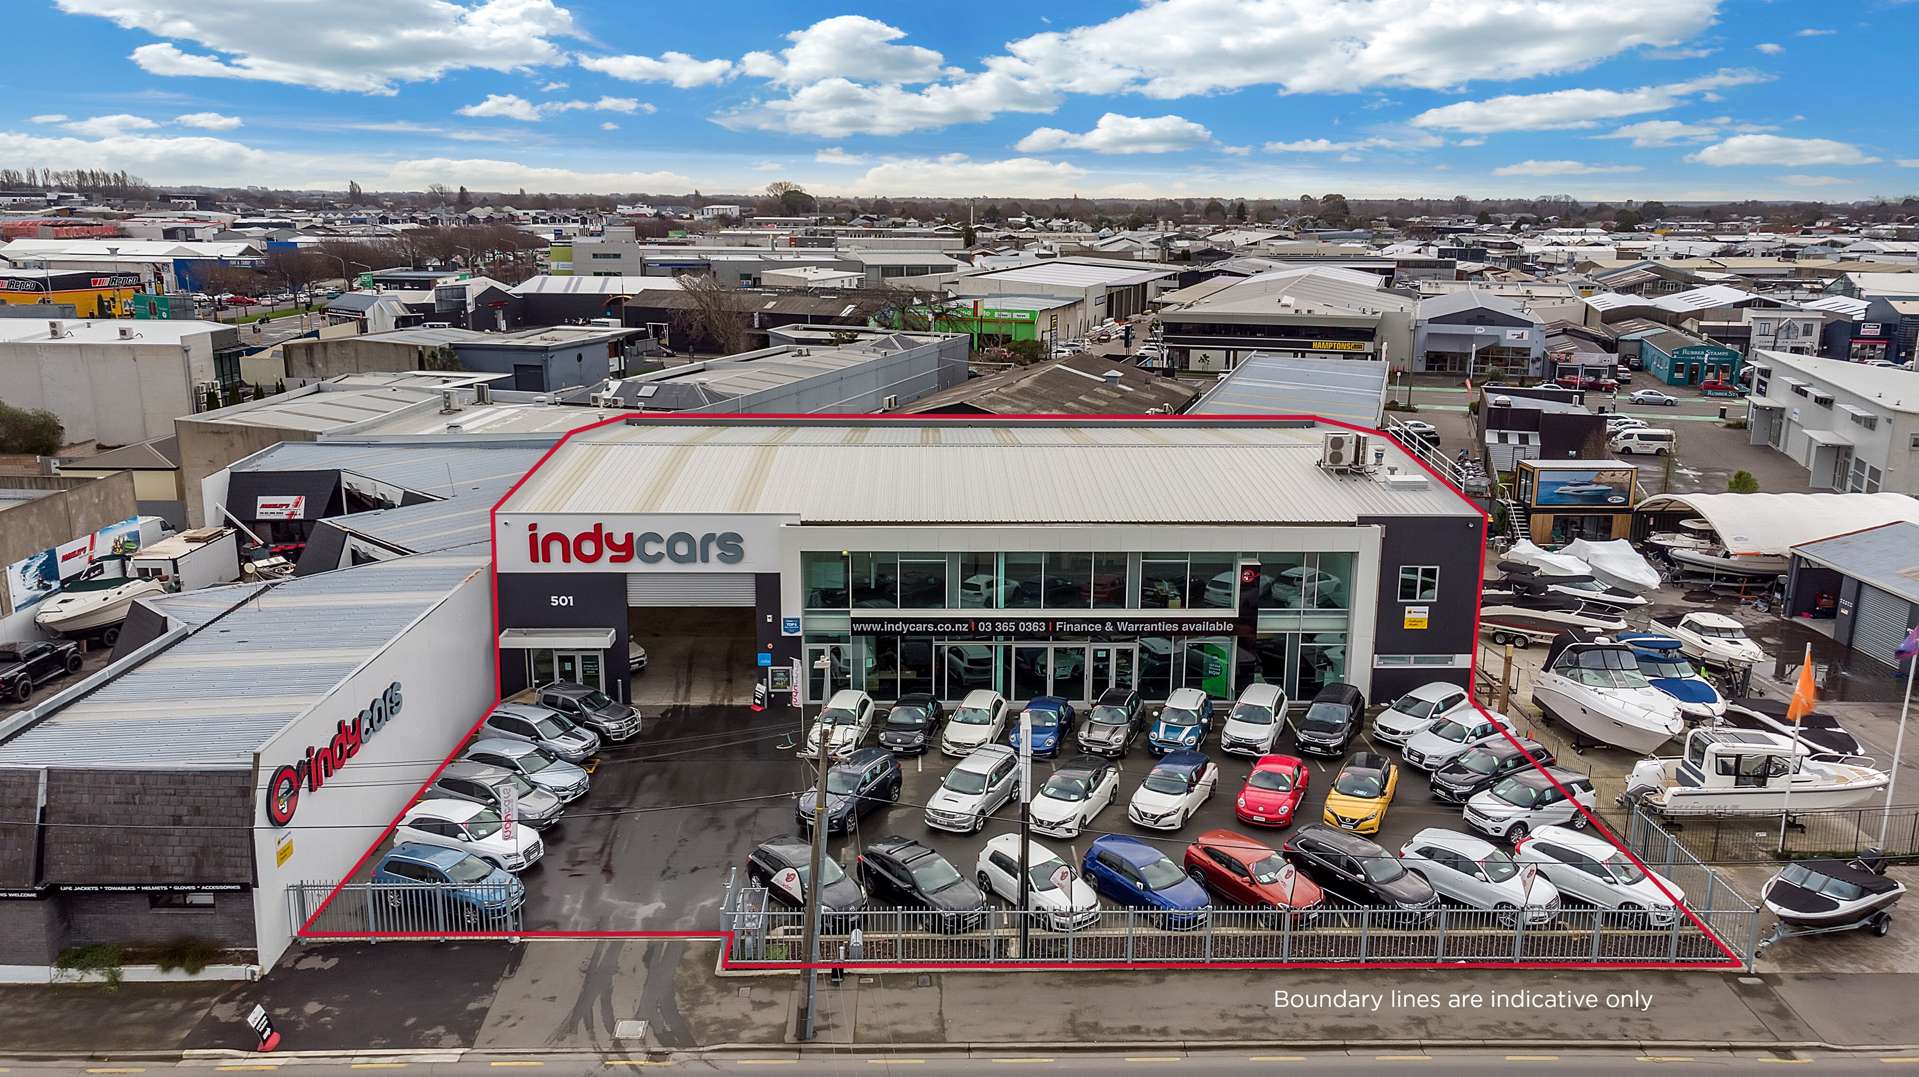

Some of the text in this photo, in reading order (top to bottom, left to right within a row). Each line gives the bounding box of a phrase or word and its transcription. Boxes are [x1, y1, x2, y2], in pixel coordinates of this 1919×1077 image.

[8, 279, 36, 290] Repco
[1312, 341, 1351, 350] HAMPTONS
[528, 522, 745, 564] indycars
[550, 595, 574, 607] 501
[853, 621, 1234, 634] www.indycars.co.nz 03 365 0363 Finance & Warranties available
[306, 681, 403, 792] indycars
